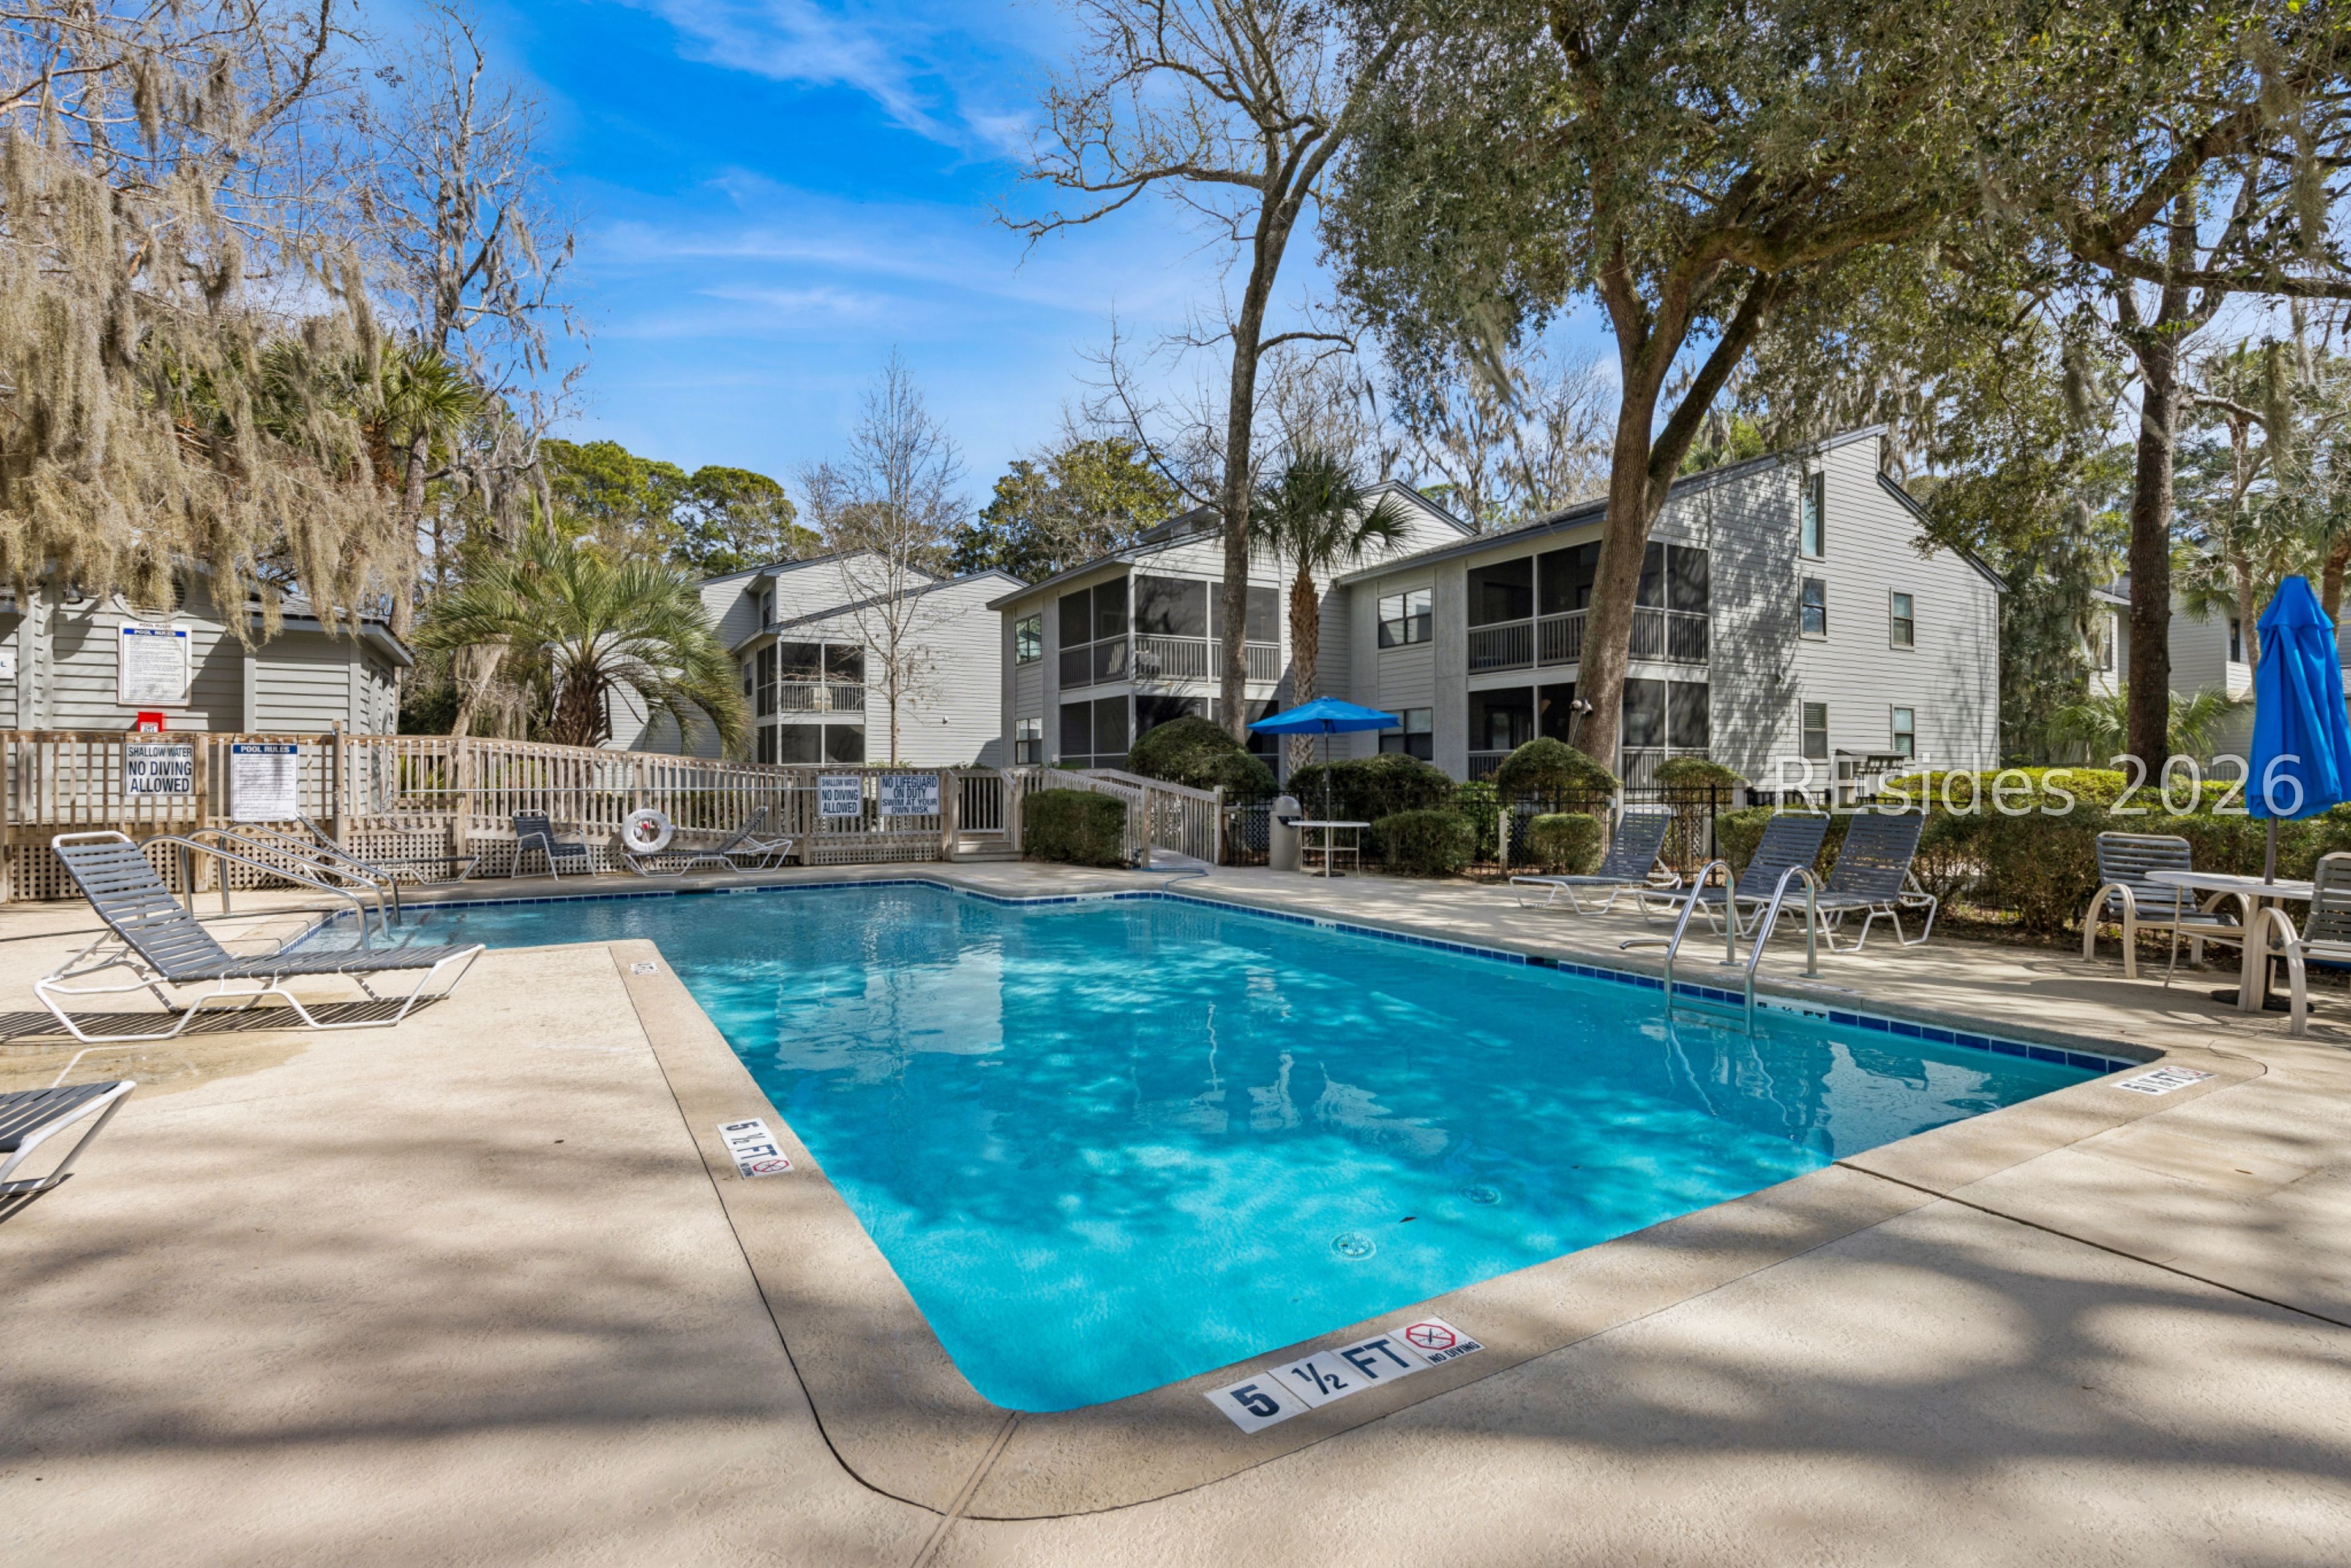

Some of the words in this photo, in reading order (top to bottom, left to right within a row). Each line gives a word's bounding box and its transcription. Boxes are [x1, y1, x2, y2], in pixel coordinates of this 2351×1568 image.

[128, 747, 166, 757] SHALLOW
[167, 747, 192, 757] WATER
[129, 760, 146, 775] NO
[150, 760, 192, 775] DIVING
[130, 778, 189, 792] ALLOWED
[882, 776, 893, 788] NO
[895, 776, 937, 788] LIFEGUARD
[822, 789, 831, 800] NO
[834, 789, 858, 800] DIVING
[894, 788, 904, 798] ON
[907, 788, 926, 798] DUTY
[823, 802, 857, 813] ALLOWED
[726, 1121, 759, 1131] 5
[737, 1144, 778, 1160] FT
[1428, 1353, 1447, 1363] NO
[1444, 1341, 1481, 1357] DIVING
[1229, 1384, 1280, 1417] 5
[1341, 1339, 1411, 1379] FT
